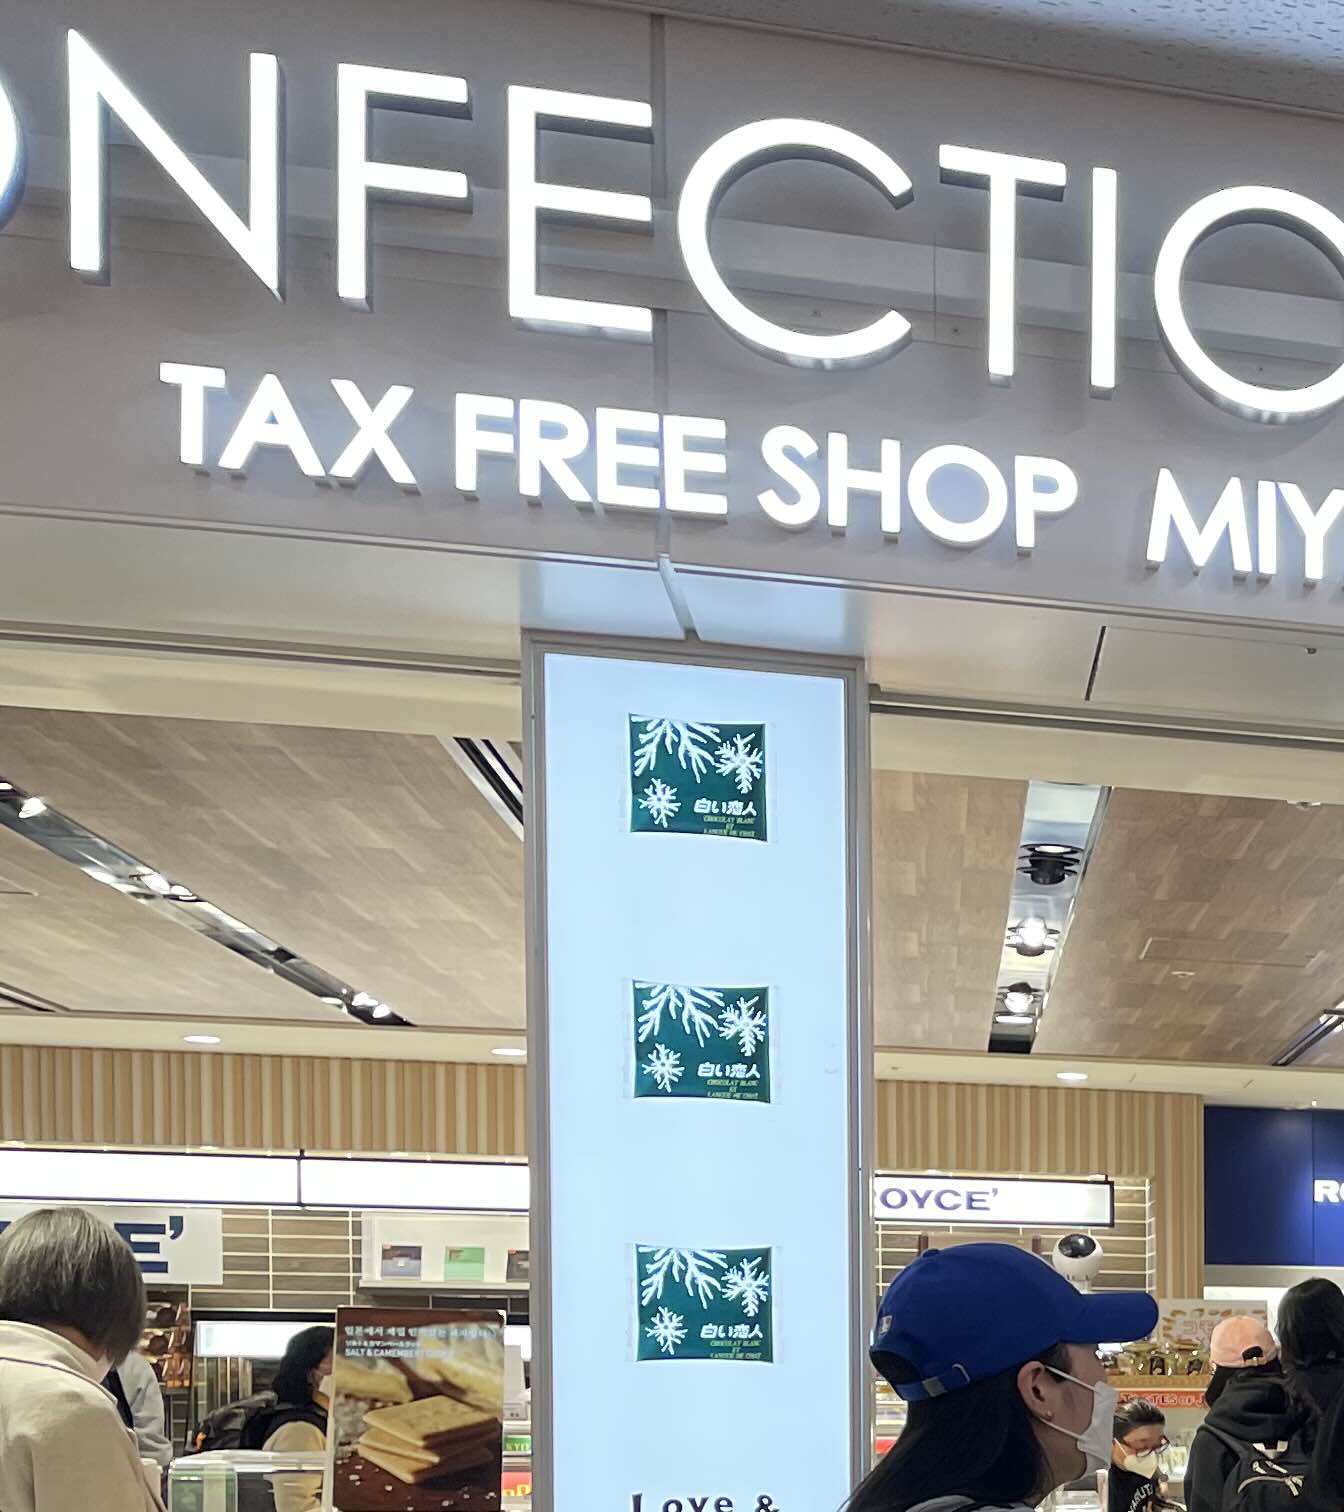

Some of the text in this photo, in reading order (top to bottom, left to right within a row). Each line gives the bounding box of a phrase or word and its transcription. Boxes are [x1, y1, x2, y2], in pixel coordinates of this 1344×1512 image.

[160, 362, 416, 485] TAX
[455, 392, 728, 516] FREE
[757, 424, 1078, 548] SHOP
[875, 1187, 998, 1211] OYCE'
[700, 1323, 763, 1338] 白い恋人
